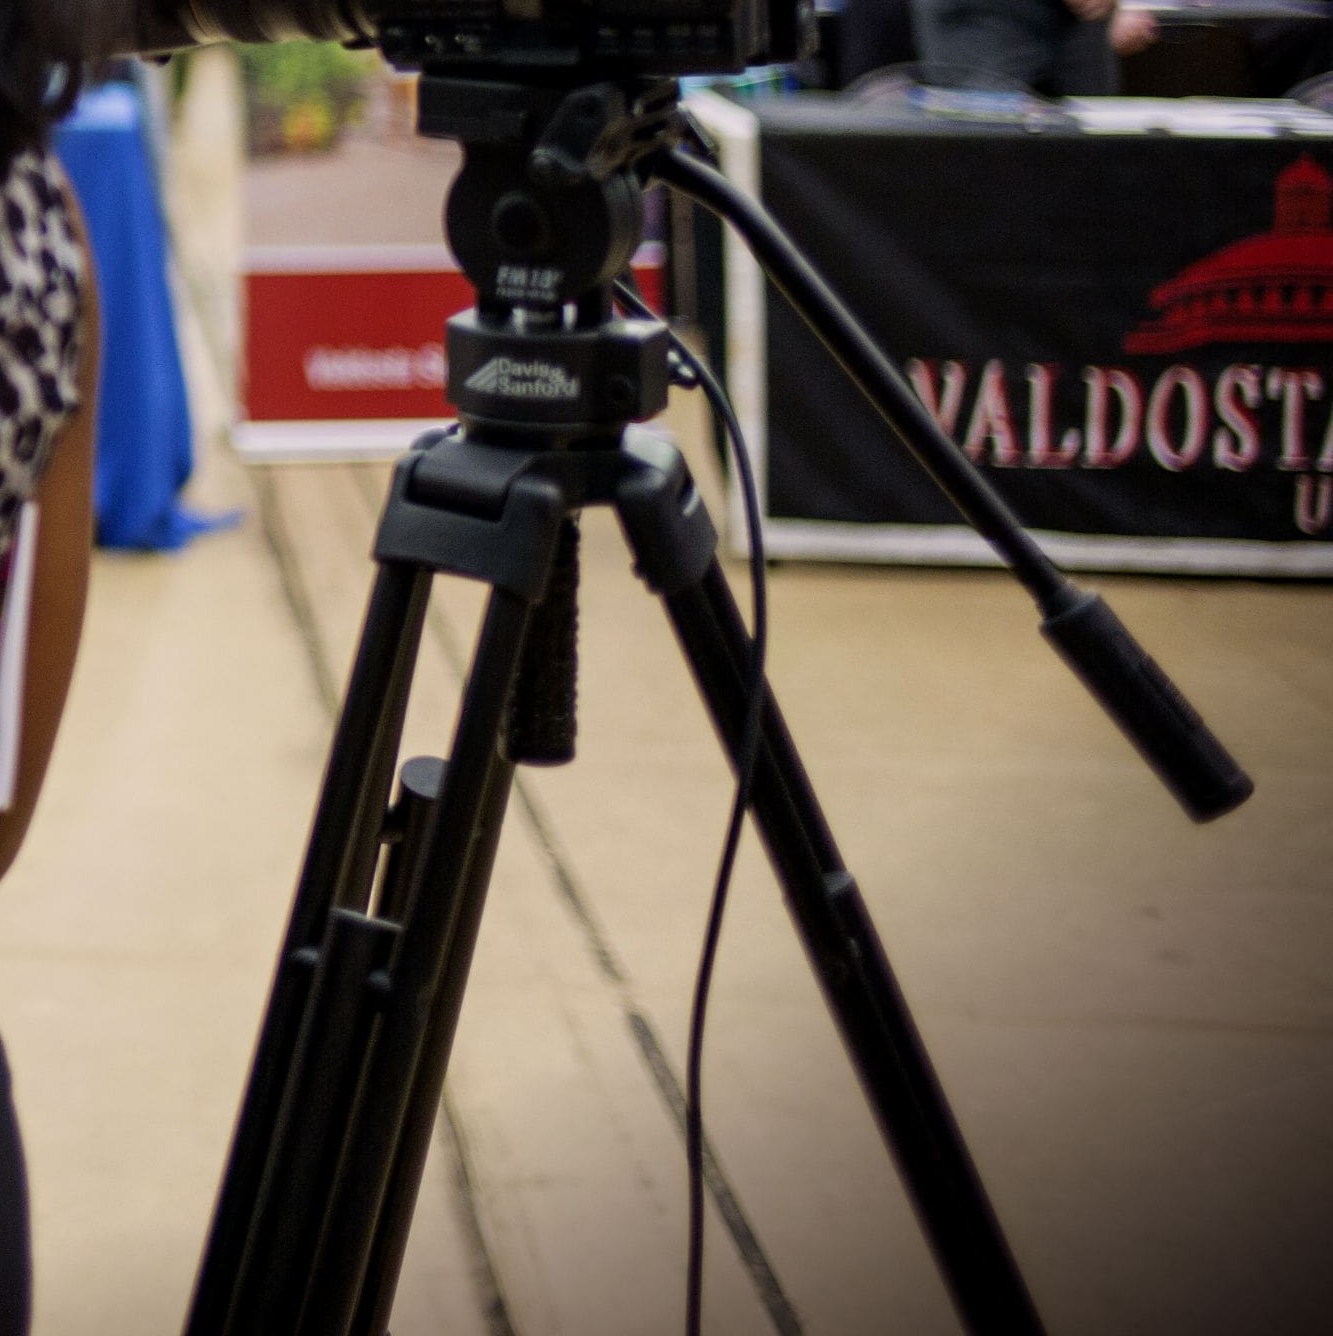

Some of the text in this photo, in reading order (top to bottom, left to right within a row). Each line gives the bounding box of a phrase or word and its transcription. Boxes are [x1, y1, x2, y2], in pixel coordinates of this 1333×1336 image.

[498, 356, 549, 377] Davis
[498, 376, 579, 398] Sanford
[905, 357, 1333, 472] VALDOST
